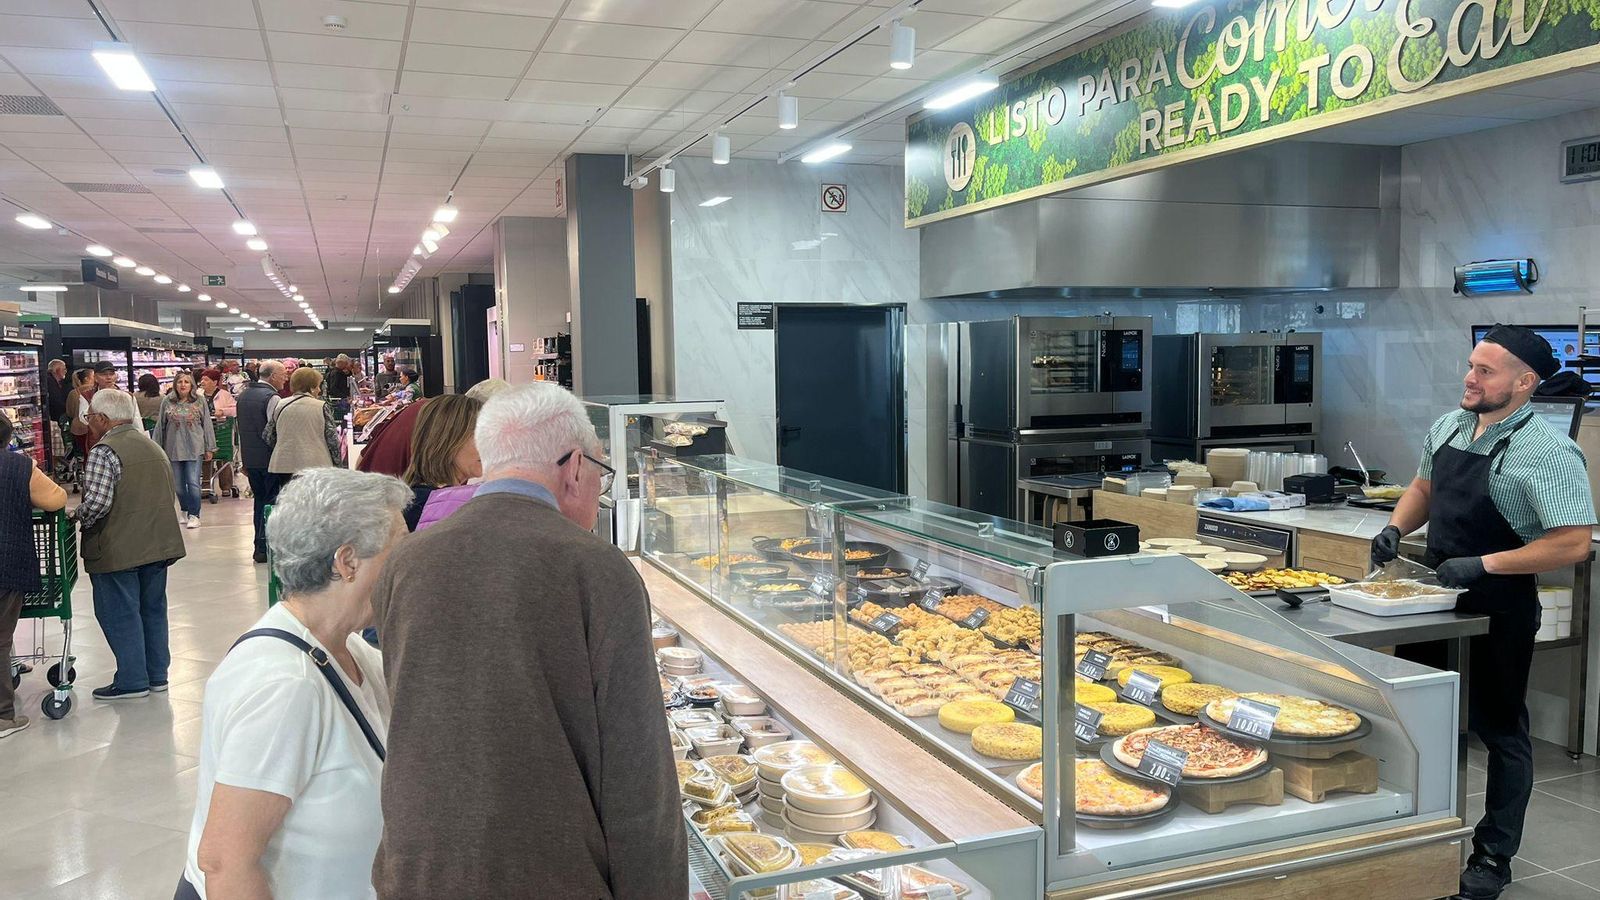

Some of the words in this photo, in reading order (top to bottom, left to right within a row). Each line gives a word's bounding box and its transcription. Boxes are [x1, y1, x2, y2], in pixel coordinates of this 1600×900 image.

[989, 86, 1067, 146] LISTO
[1077, 48, 1172, 117] PARA
[1175, 0, 1384, 90] Come
[1139, 68, 1283, 154] READY
[1299, 43, 1375, 109] TO
[1571, 142, 1600, 164] 11:0
